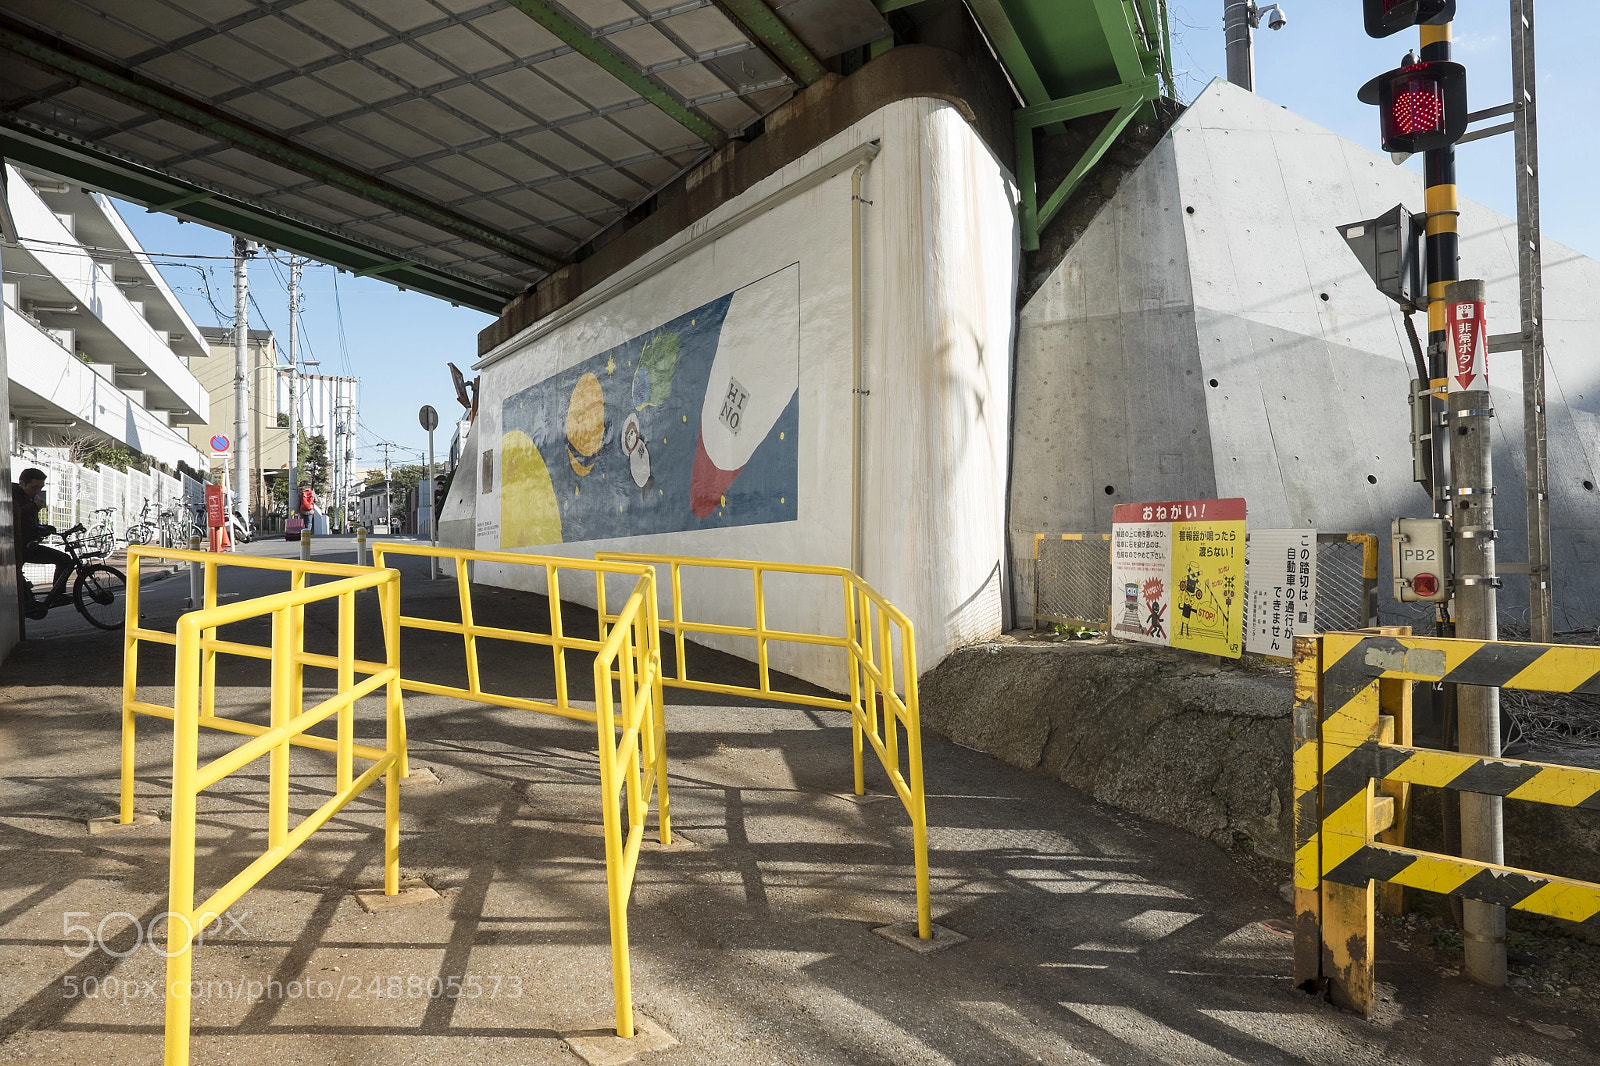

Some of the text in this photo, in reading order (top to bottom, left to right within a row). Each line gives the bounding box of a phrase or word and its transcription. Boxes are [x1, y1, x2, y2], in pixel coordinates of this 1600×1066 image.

[1458, 322, 1472, 374] 非常ボタン
[1179, 530, 1236, 541] 警報器が鳴ったら
[1404, 549, 1435, 561] PB2
[1284, 547, 1296, 639] 自動車の通行が
[1300, 535, 1310, 607] この踏切は、
[1198, 608, 1215, 622] STOP!
[1271, 587, 1282, 650] できません
